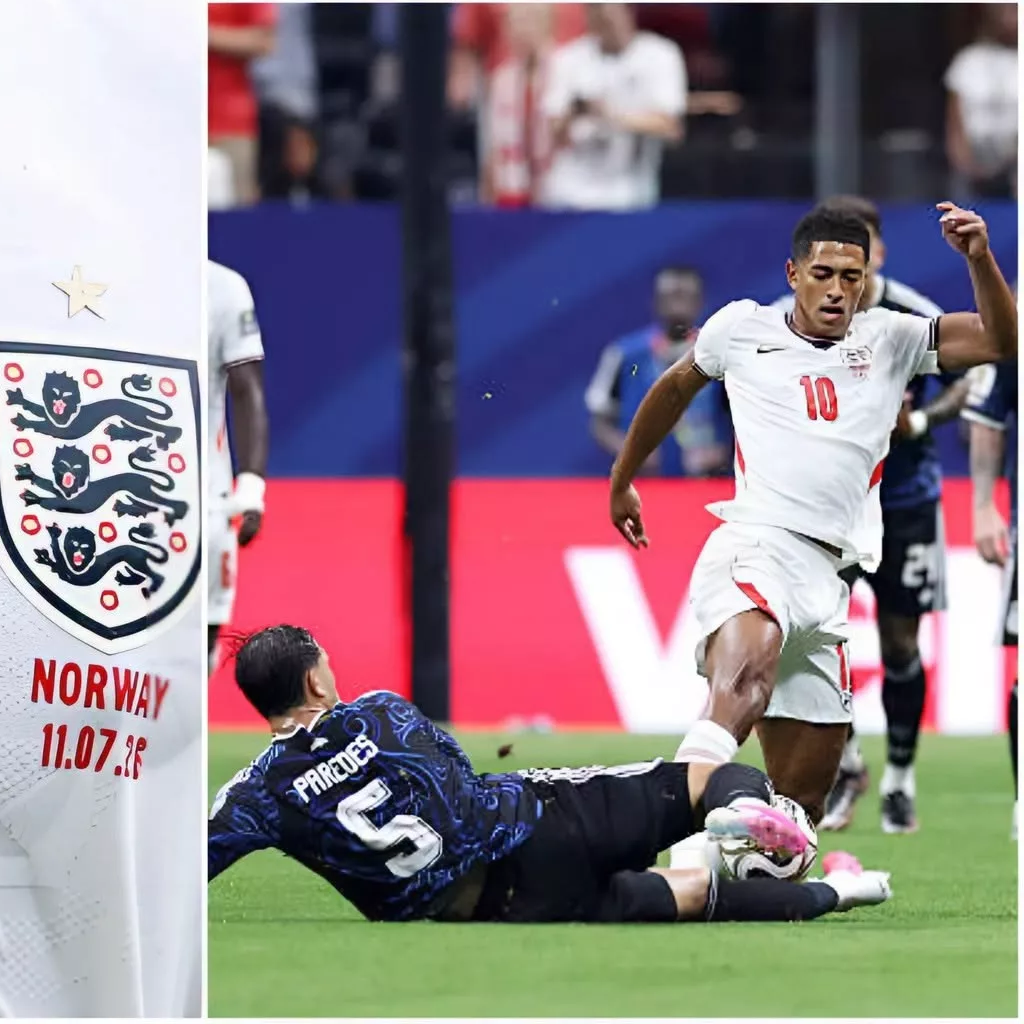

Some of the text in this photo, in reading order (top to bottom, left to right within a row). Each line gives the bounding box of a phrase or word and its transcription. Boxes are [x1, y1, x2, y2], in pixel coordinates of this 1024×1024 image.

[799, 375, 839, 422] 10
[30, 657, 170, 721] NORWAY
[292, 733, 380, 803] PAREDES
[335, 777, 444, 878] 5
